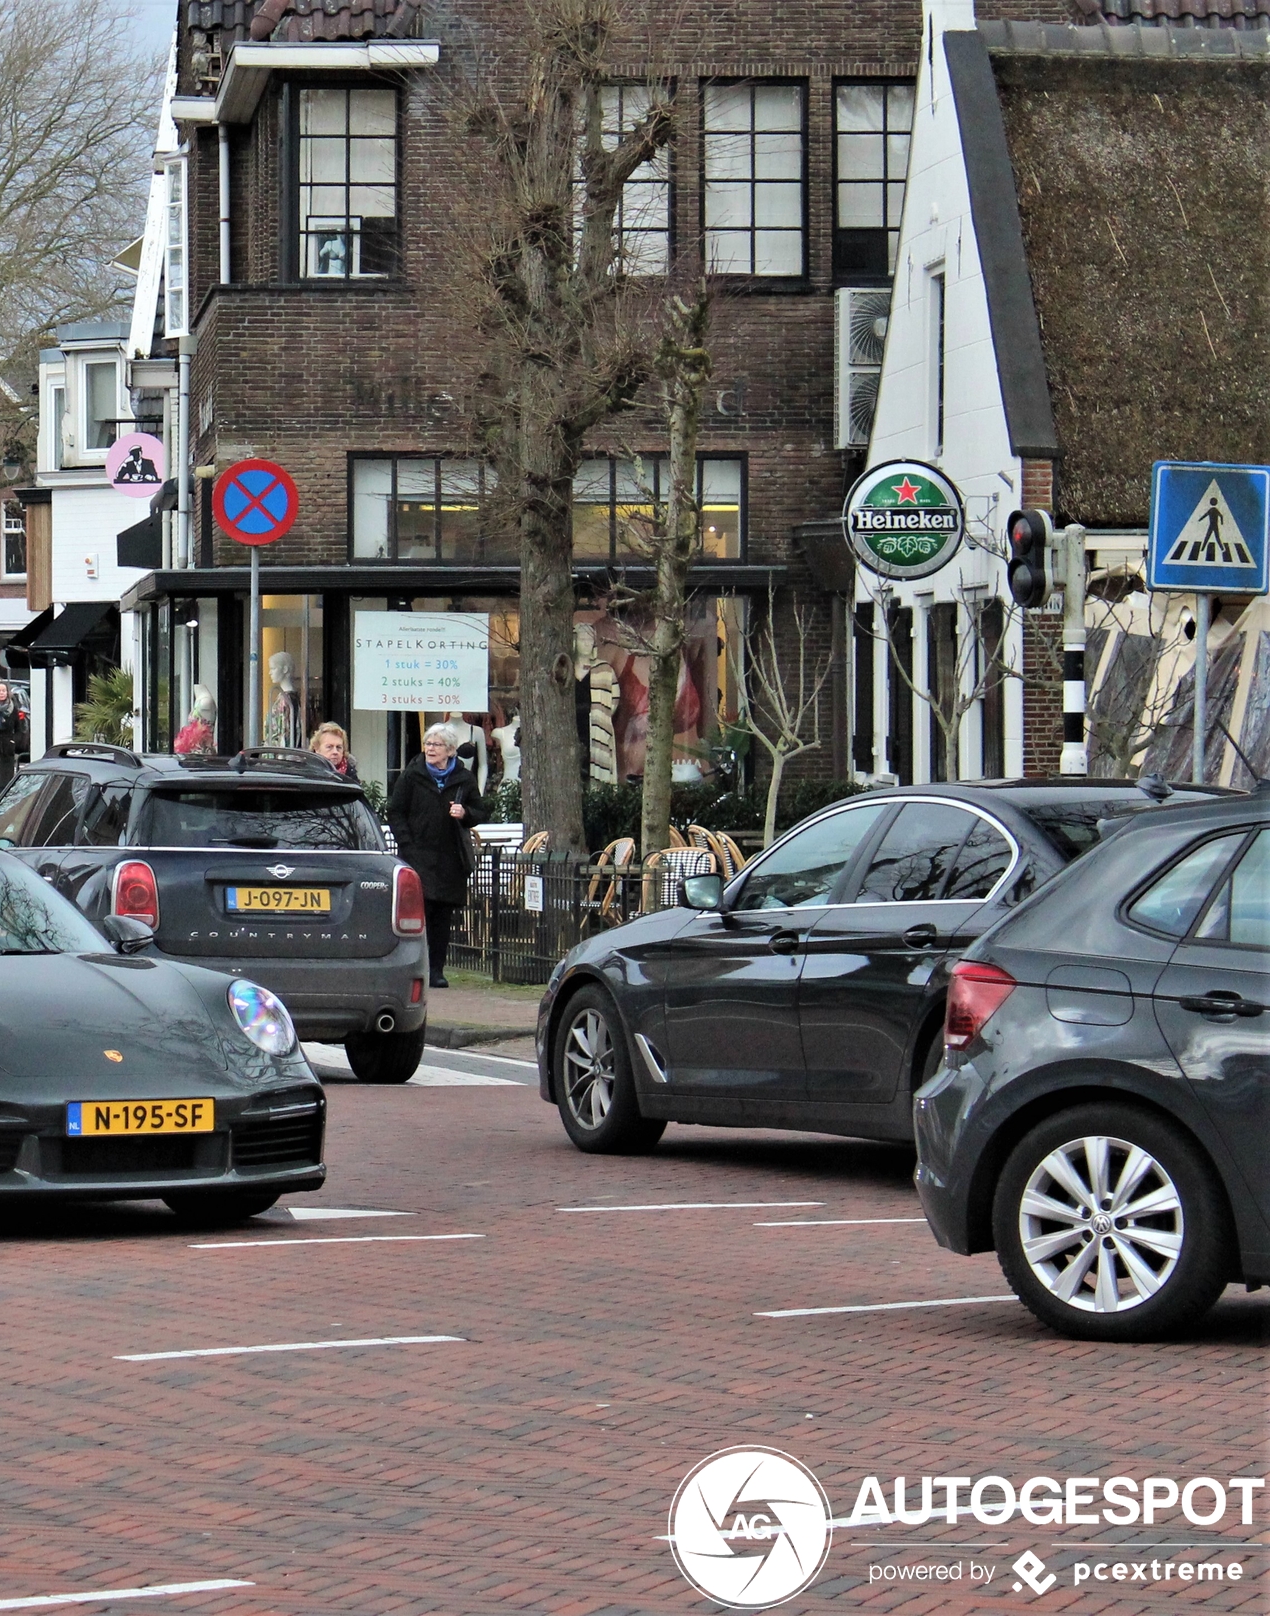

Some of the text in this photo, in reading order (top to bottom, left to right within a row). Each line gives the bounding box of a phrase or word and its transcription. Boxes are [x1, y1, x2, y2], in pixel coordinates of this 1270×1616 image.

[856, 510, 955, 530] Heineken
[356, 638, 488, 650] STAPELKORTING
[385, 659, 391, 668] 1
[395, 659, 420, 669] stuk
[436, 660, 459, 670] 30%
[382, 677, 388, 687] 2
[392, 677, 423, 687] stuks
[438, 677, 461, 687] 40%
[382, 694, 388, 704] 3
[392, 694, 423, 704] stuks
[438, 695, 461, 705] 50%
[360, 881, 385, 890] COOPER
[243, 891, 322, 908] J-097-JN
[189, 931, 367, 940] COUNTRYMAN
[68, 1103, 204, 1130] NL N-195-SF
